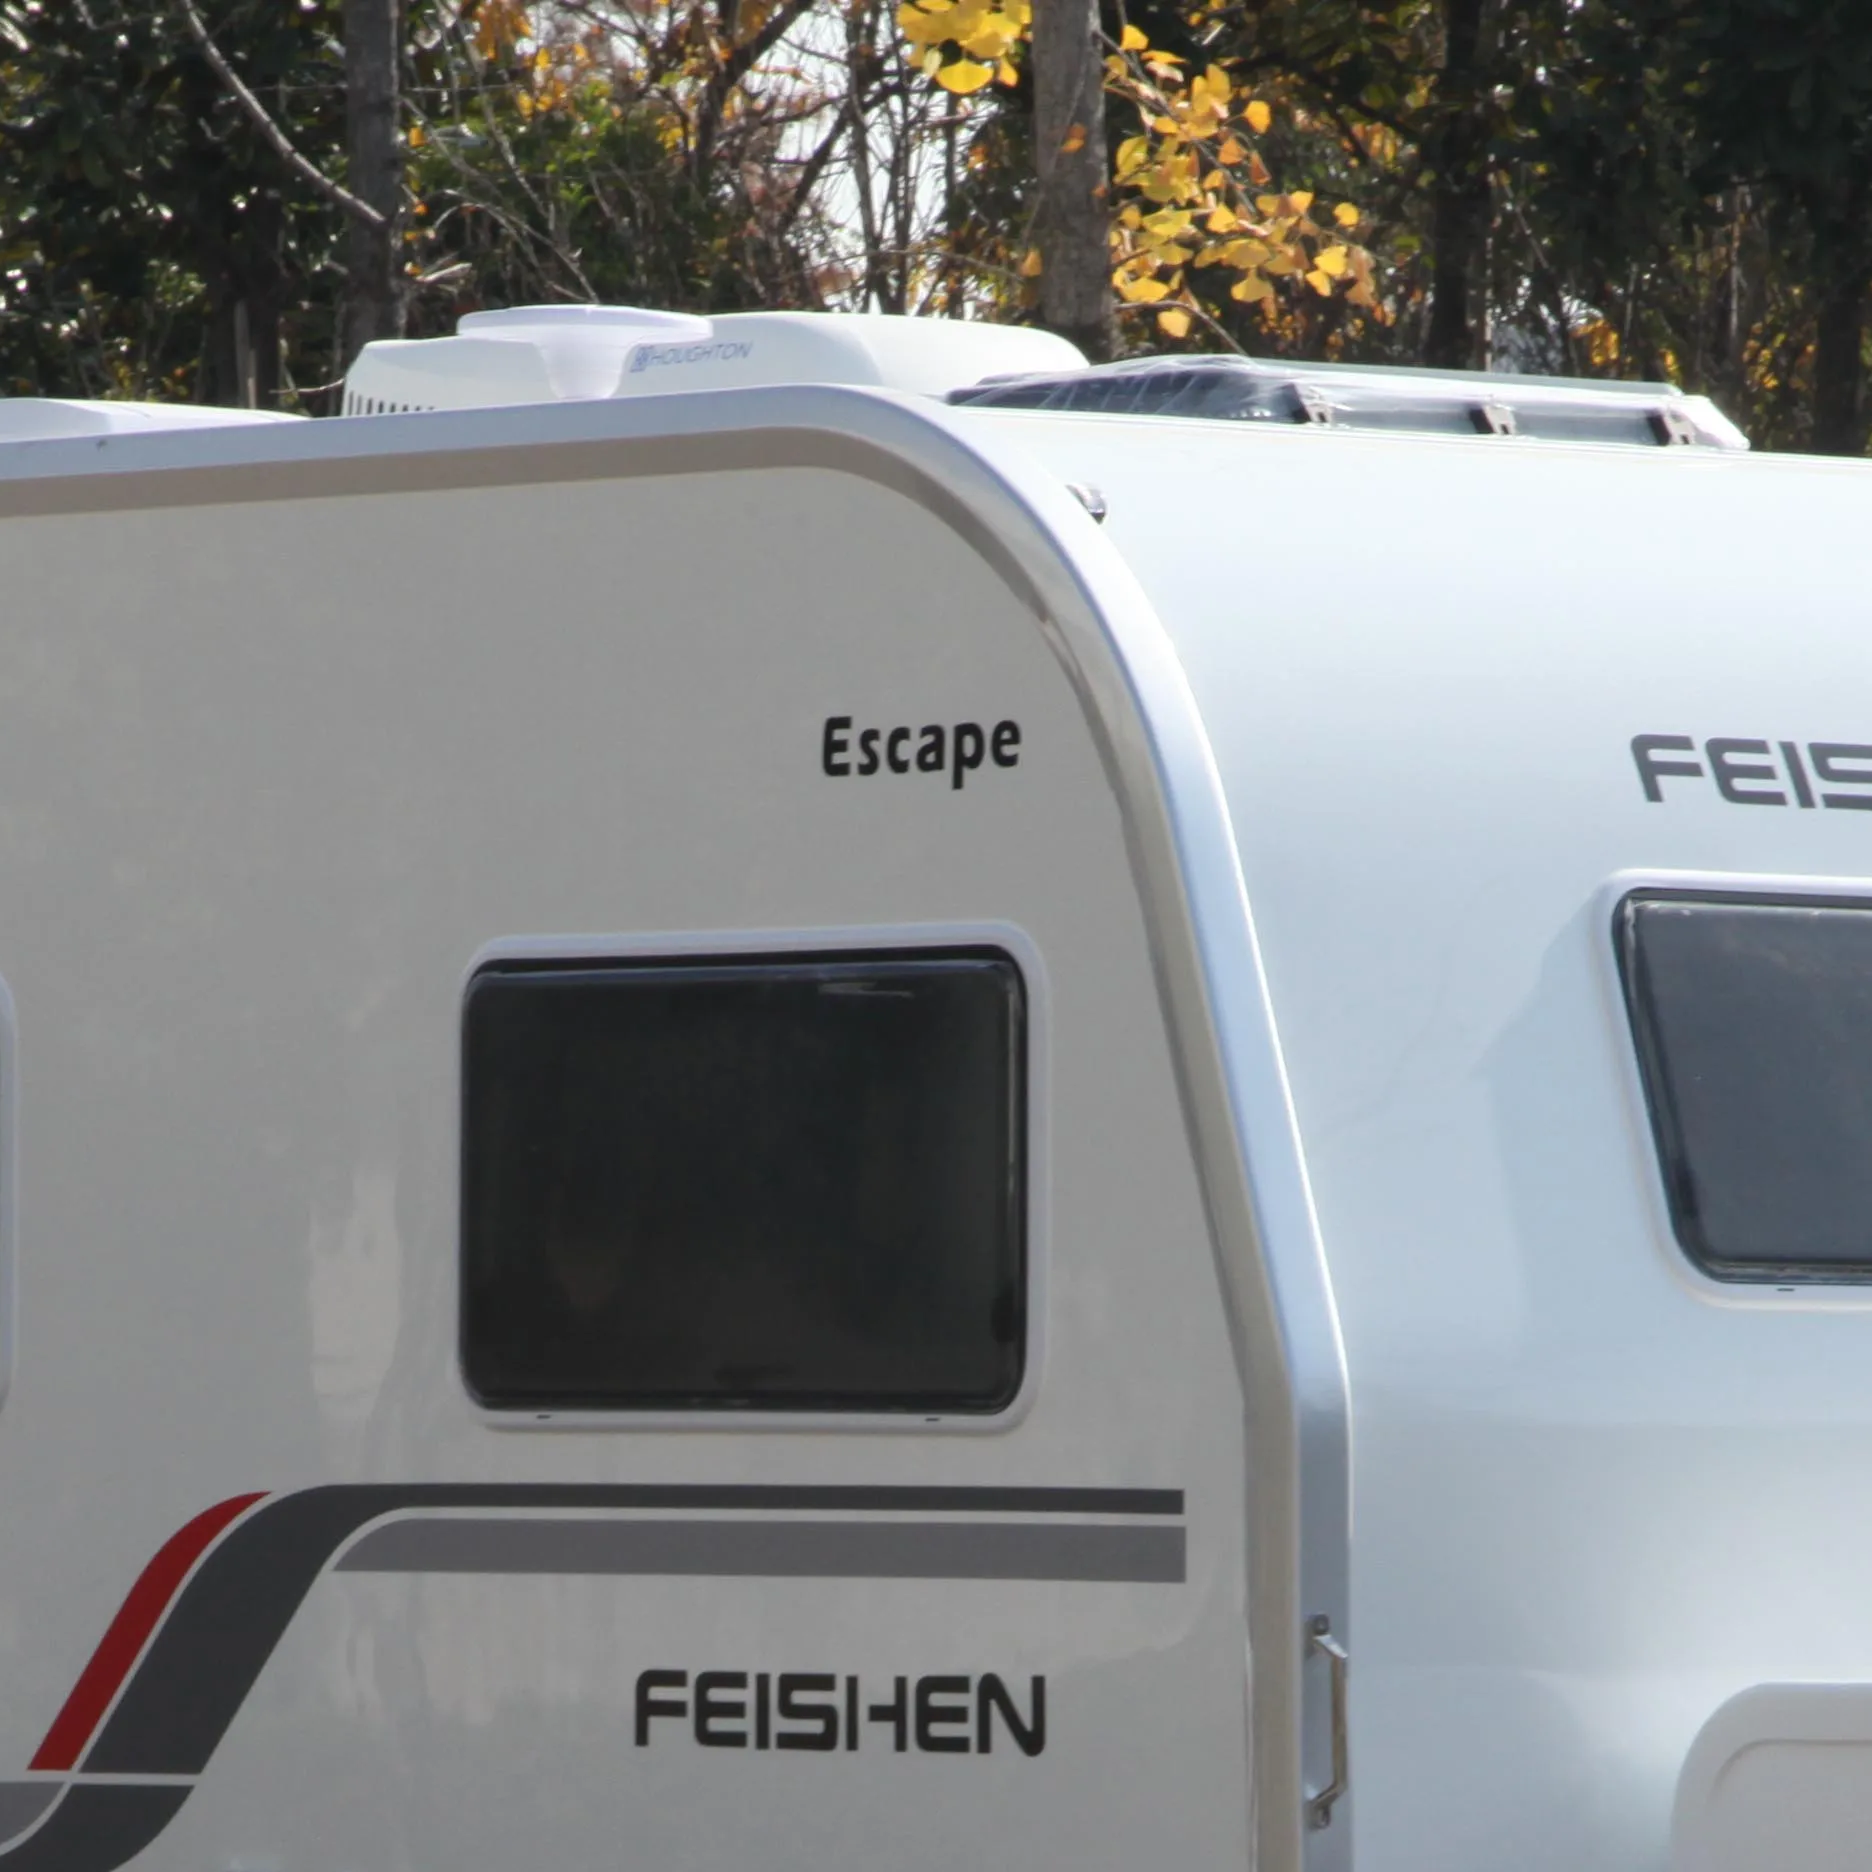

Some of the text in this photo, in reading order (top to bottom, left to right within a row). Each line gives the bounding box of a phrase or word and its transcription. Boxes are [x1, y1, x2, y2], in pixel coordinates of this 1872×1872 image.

[647, 341, 753, 366] HOUGHTON
[822, 715, 1021, 790] Escape
[634, 1669, 1046, 1757] FEISHEN
